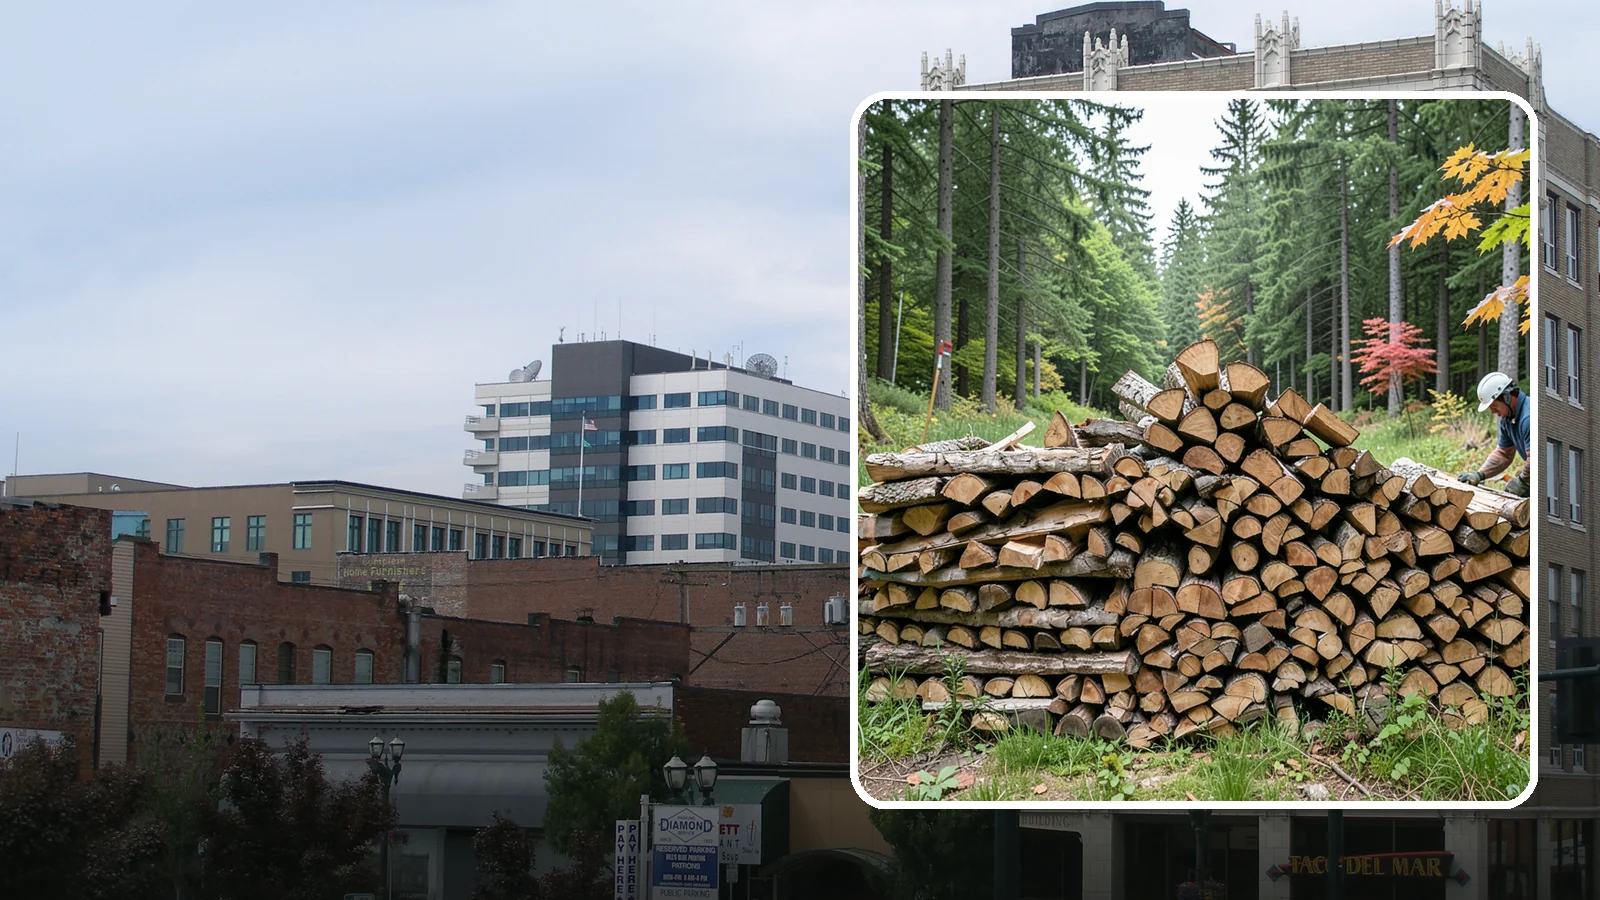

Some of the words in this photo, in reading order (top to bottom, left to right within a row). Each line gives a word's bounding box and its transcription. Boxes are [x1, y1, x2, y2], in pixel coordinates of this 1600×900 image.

[343, 567, 368, 577] Home
[370, 567, 427, 577] Furnishers
[661, 818, 713, 832] DIAMOND
[1022, 815, 1070, 827] BUILDING
[656, 845, 688, 853] RESERVED
[689, 846, 716, 854] PARKING
[722, 852, 739, 862] Soup
[1346, 856, 1385, 875] DEL
[1393, 857, 1442, 876] MAR
[617, 856, 625, 893] HERE
[628, 856, 636, 893] HERE
[661, 889, 682, 897] PUBLIC
[684, 890, 710, 898] PARKING
